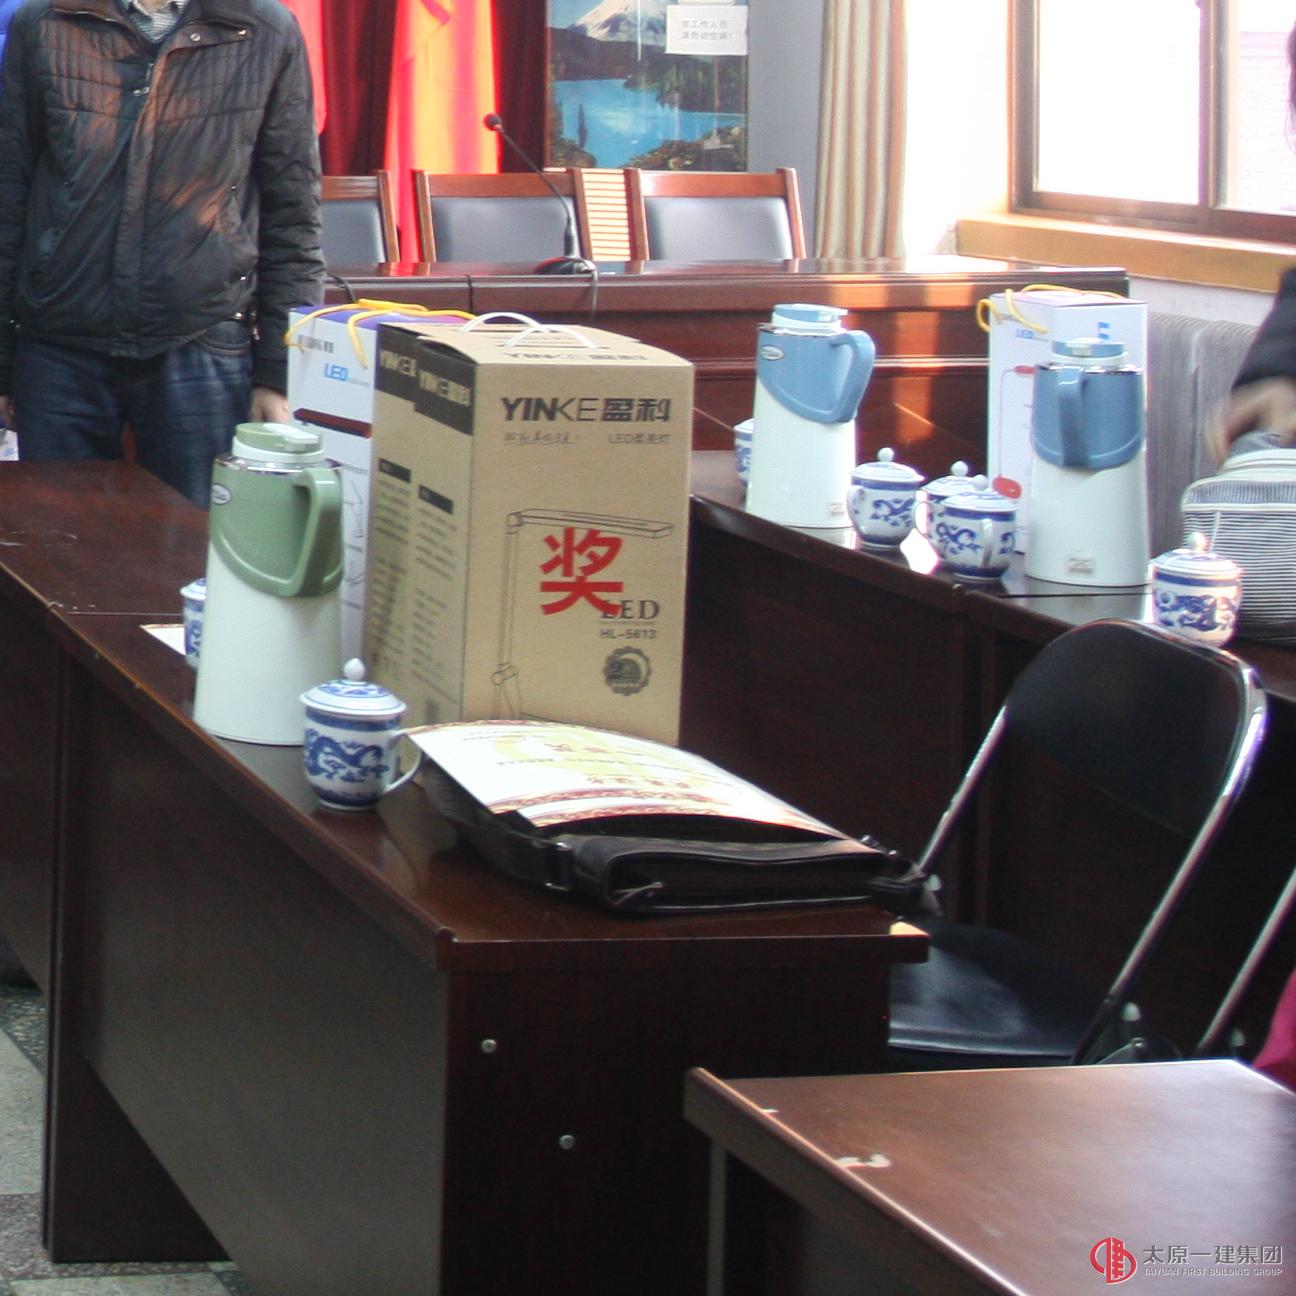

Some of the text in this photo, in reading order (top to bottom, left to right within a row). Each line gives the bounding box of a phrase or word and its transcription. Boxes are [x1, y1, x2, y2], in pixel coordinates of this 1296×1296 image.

[323, 363, 349, 382] LED
[500, 397, 671, 422] YINKE 盈科
[539, 527, 624, 616] 奖
